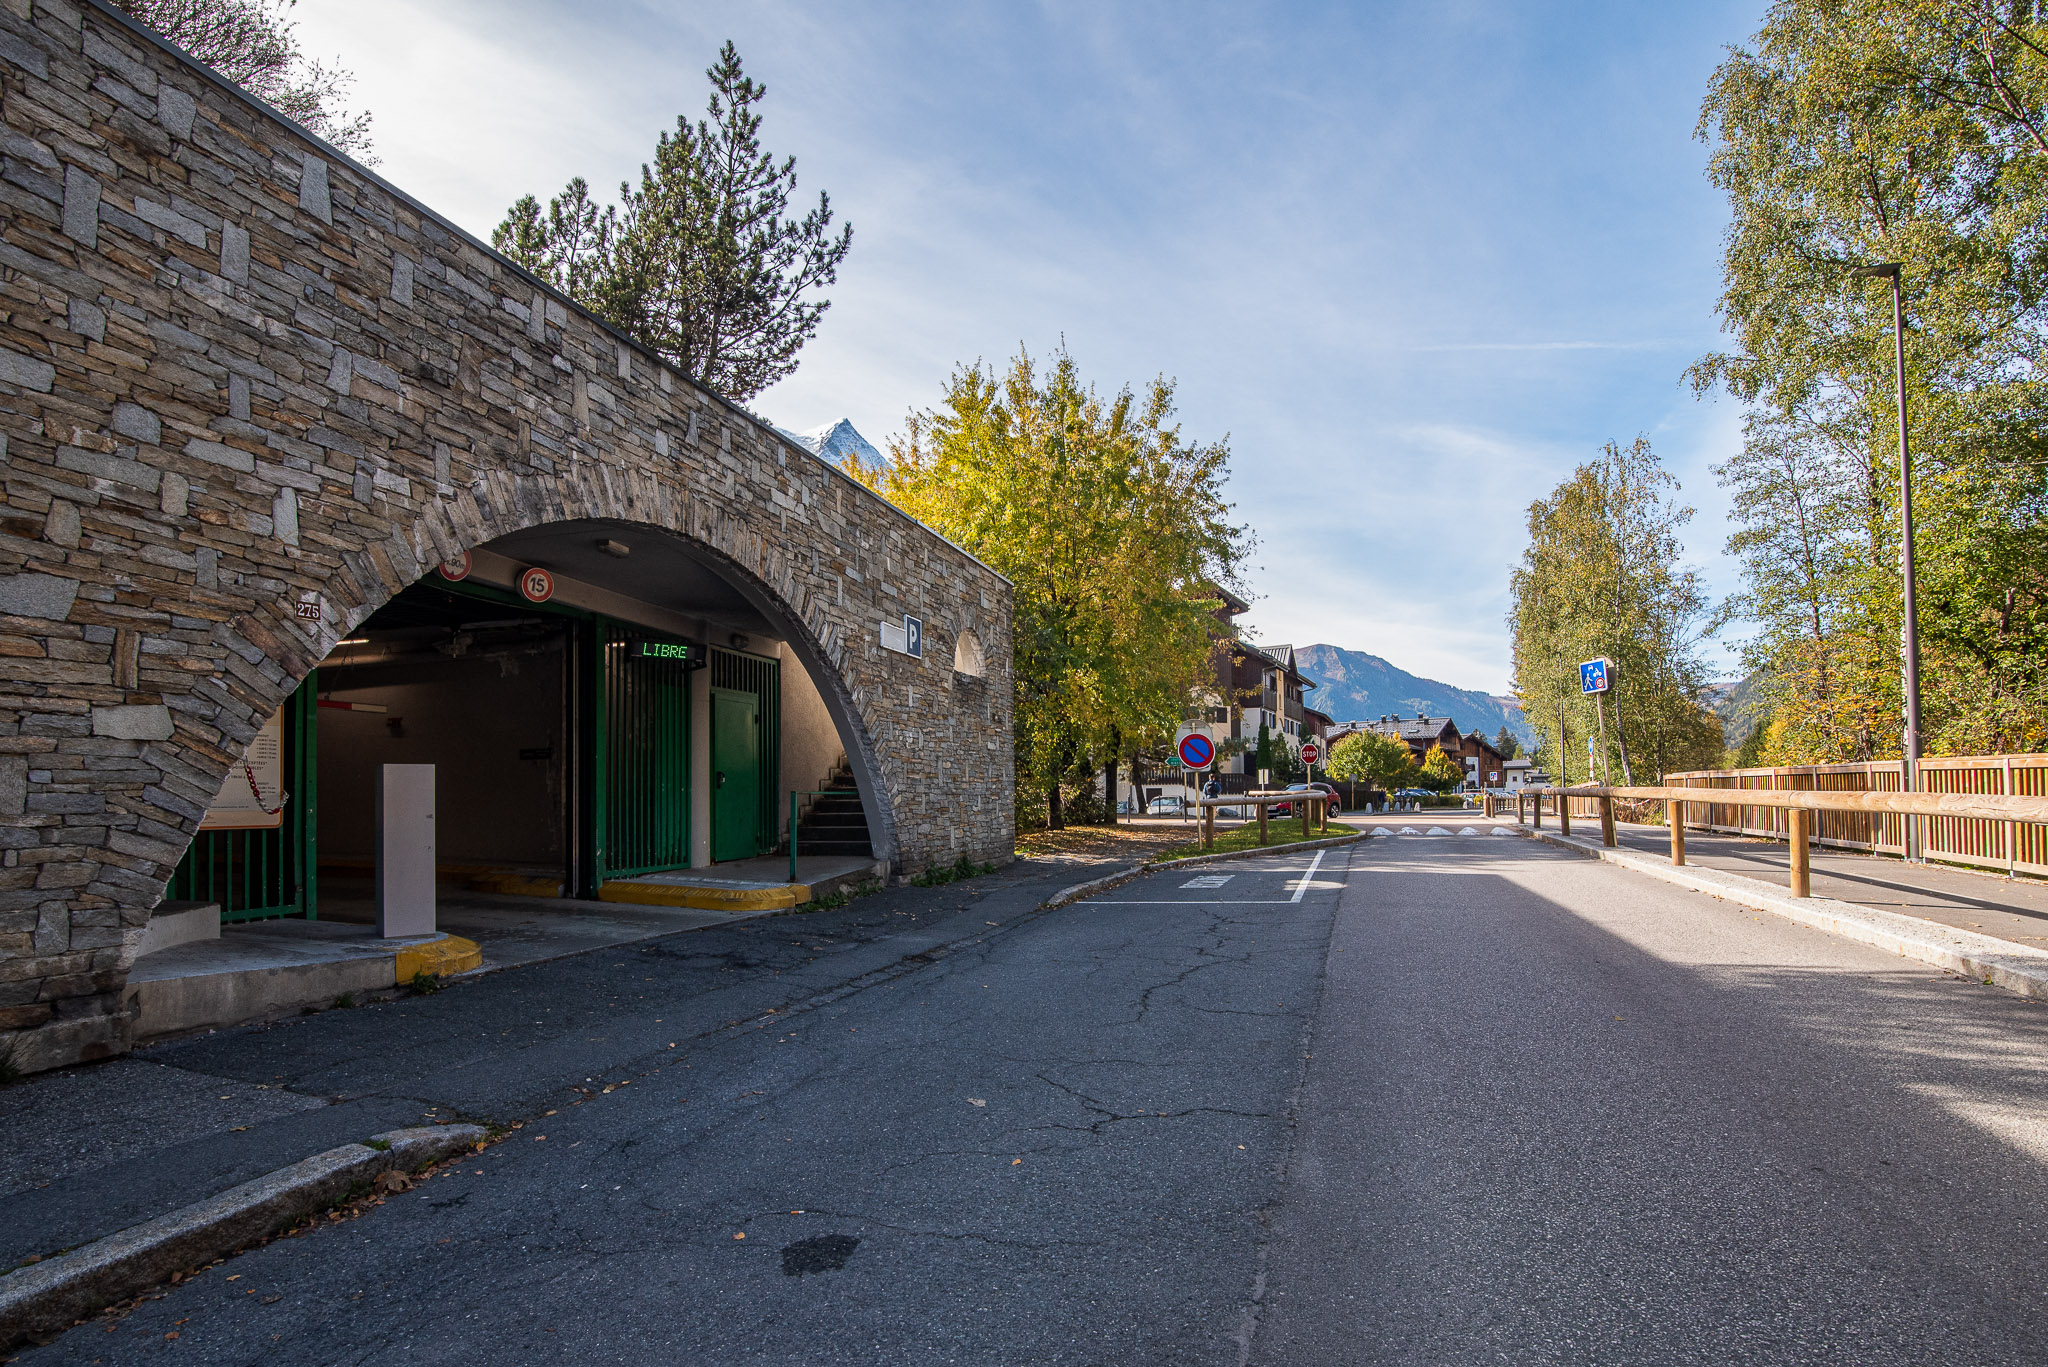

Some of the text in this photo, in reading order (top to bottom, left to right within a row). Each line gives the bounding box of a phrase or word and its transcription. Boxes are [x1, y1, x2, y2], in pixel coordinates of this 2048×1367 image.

[530, 577, 545, 593] 15
[297, 603, 319, 618] 275
[909, 623, 917, 649] P
[642, 642, 688, 659] LIBRE
[1302, 750, 1317, 758] STOP
